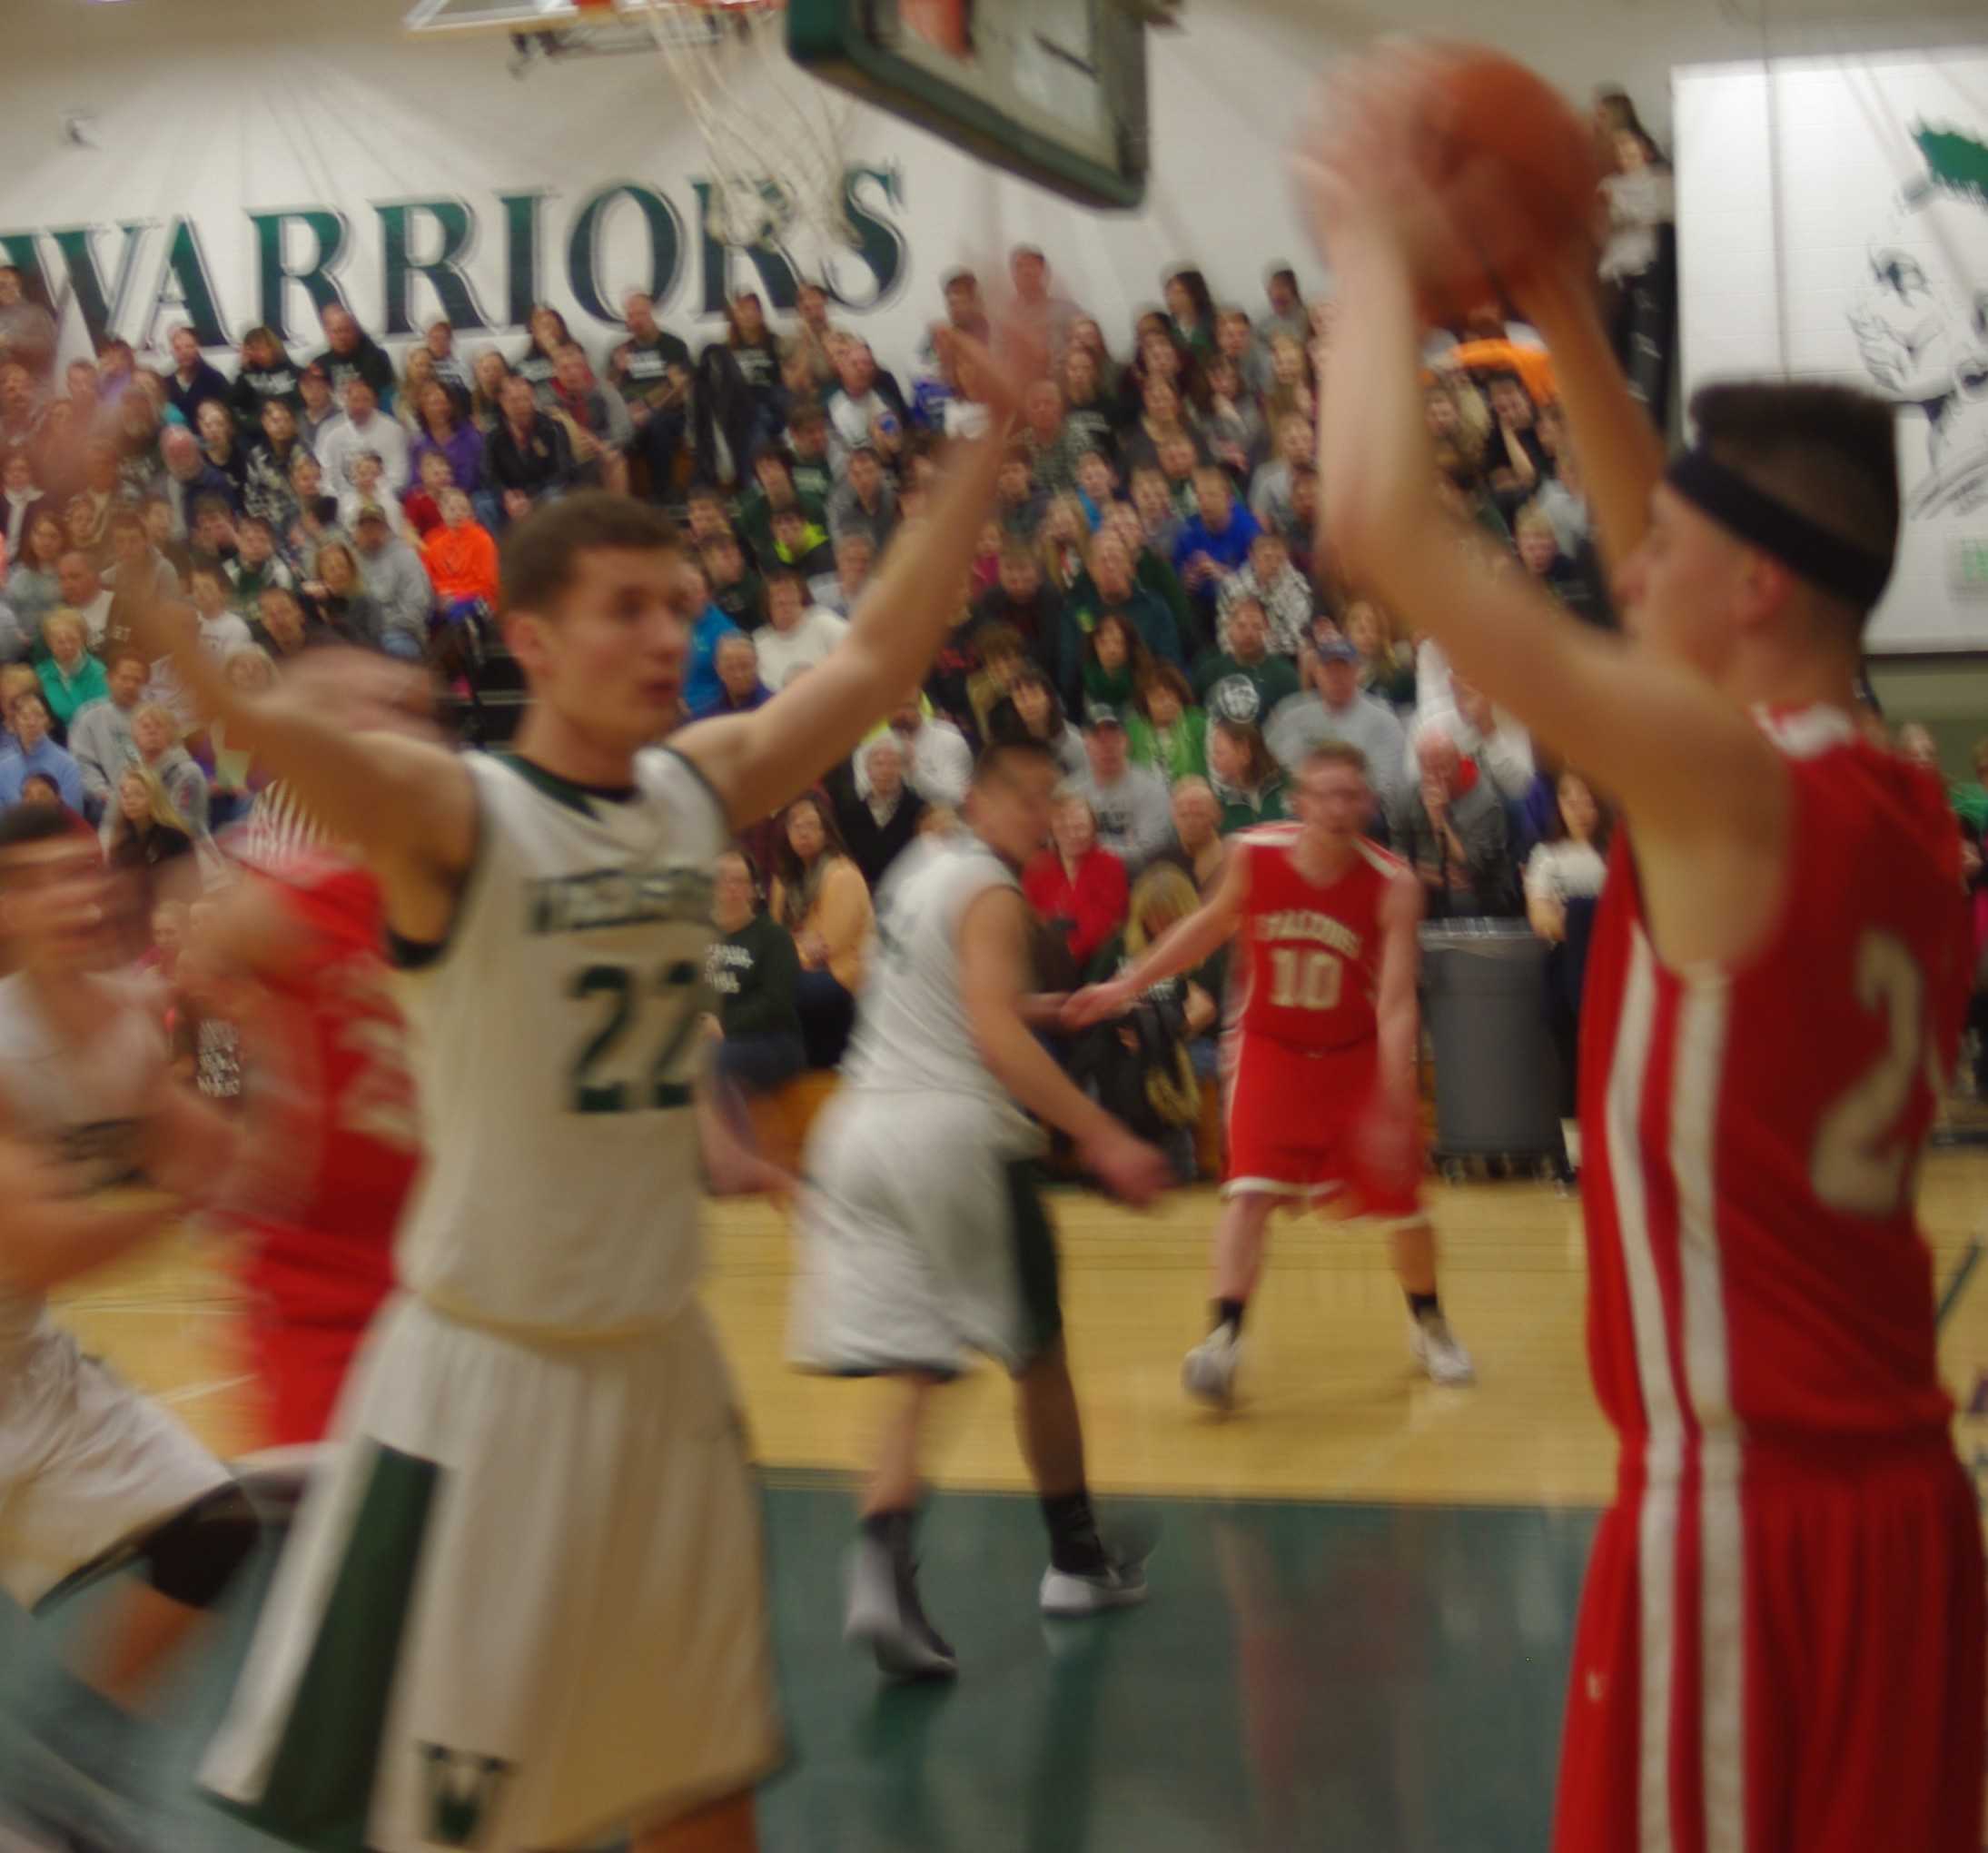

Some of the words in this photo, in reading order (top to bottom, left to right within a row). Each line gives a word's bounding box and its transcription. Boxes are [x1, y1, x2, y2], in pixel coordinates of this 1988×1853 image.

[0, 160, 906, 354] WARRIORS
[565, 961, 704, 1114] 22
[1270, 947, 1343, 1010] 10
